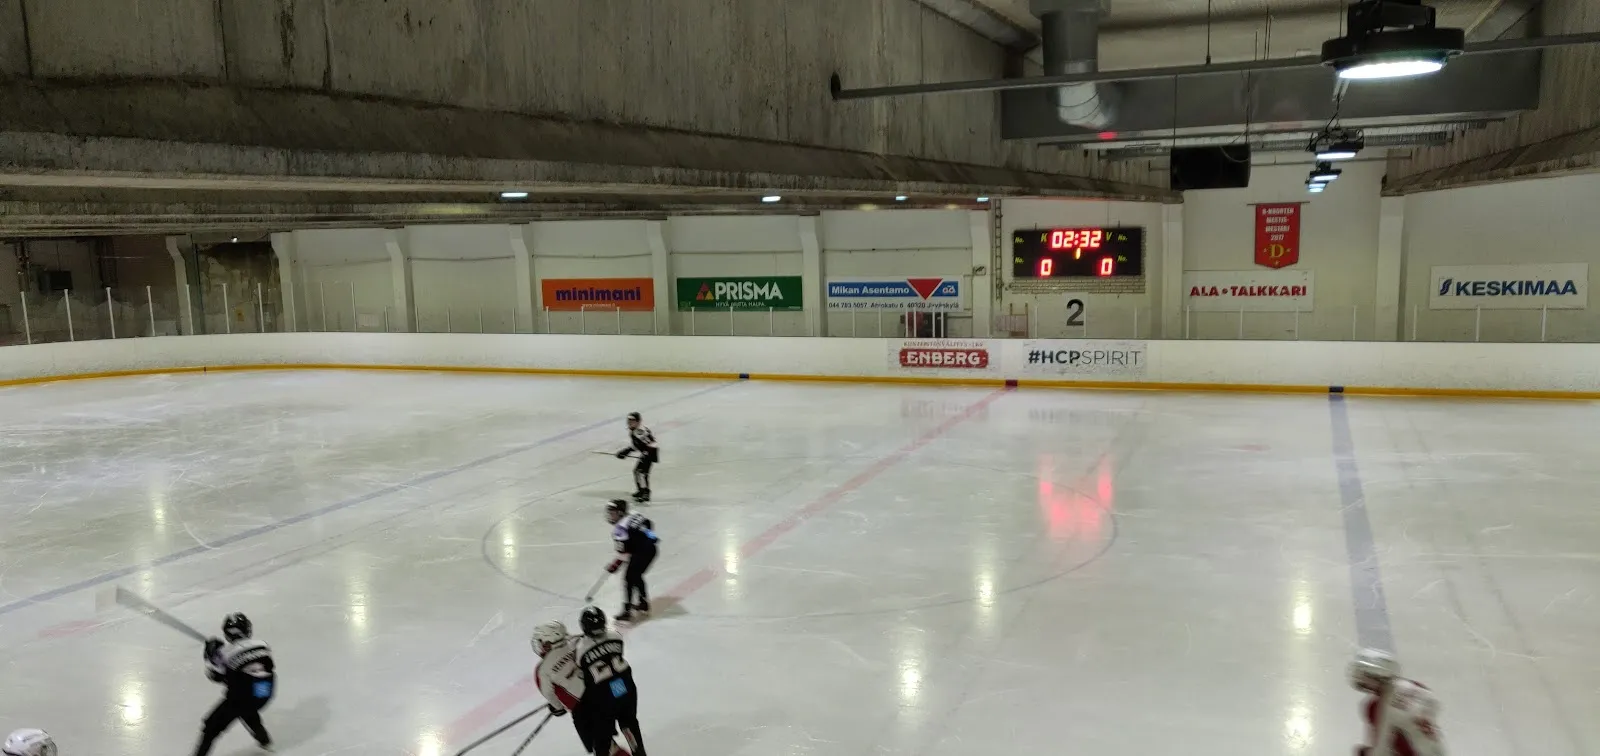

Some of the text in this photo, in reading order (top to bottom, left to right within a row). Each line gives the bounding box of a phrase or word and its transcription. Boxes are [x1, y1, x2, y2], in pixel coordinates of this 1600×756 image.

[1051, 230, 1101, 248] 02:32
[1040, 258, 1052, 276] 0
[1101, 257, 1113, 275] 0
[555, 286, 641, 302] minimani
[714, 281, 784, 300] PRISMA
[831, 286, 860, 294] Mikan
[861, 286, 910, 294] Asentamo
[1230, 285, 1307, 296] TALKKARI
[1456, 280, 1577, 296] KESKIMAA
[1066, 299, 1084, 326] 2
[907, 351, 980, 365] ENBERG
[1028, 350, 1141, 366] #HCPSPIRIT
